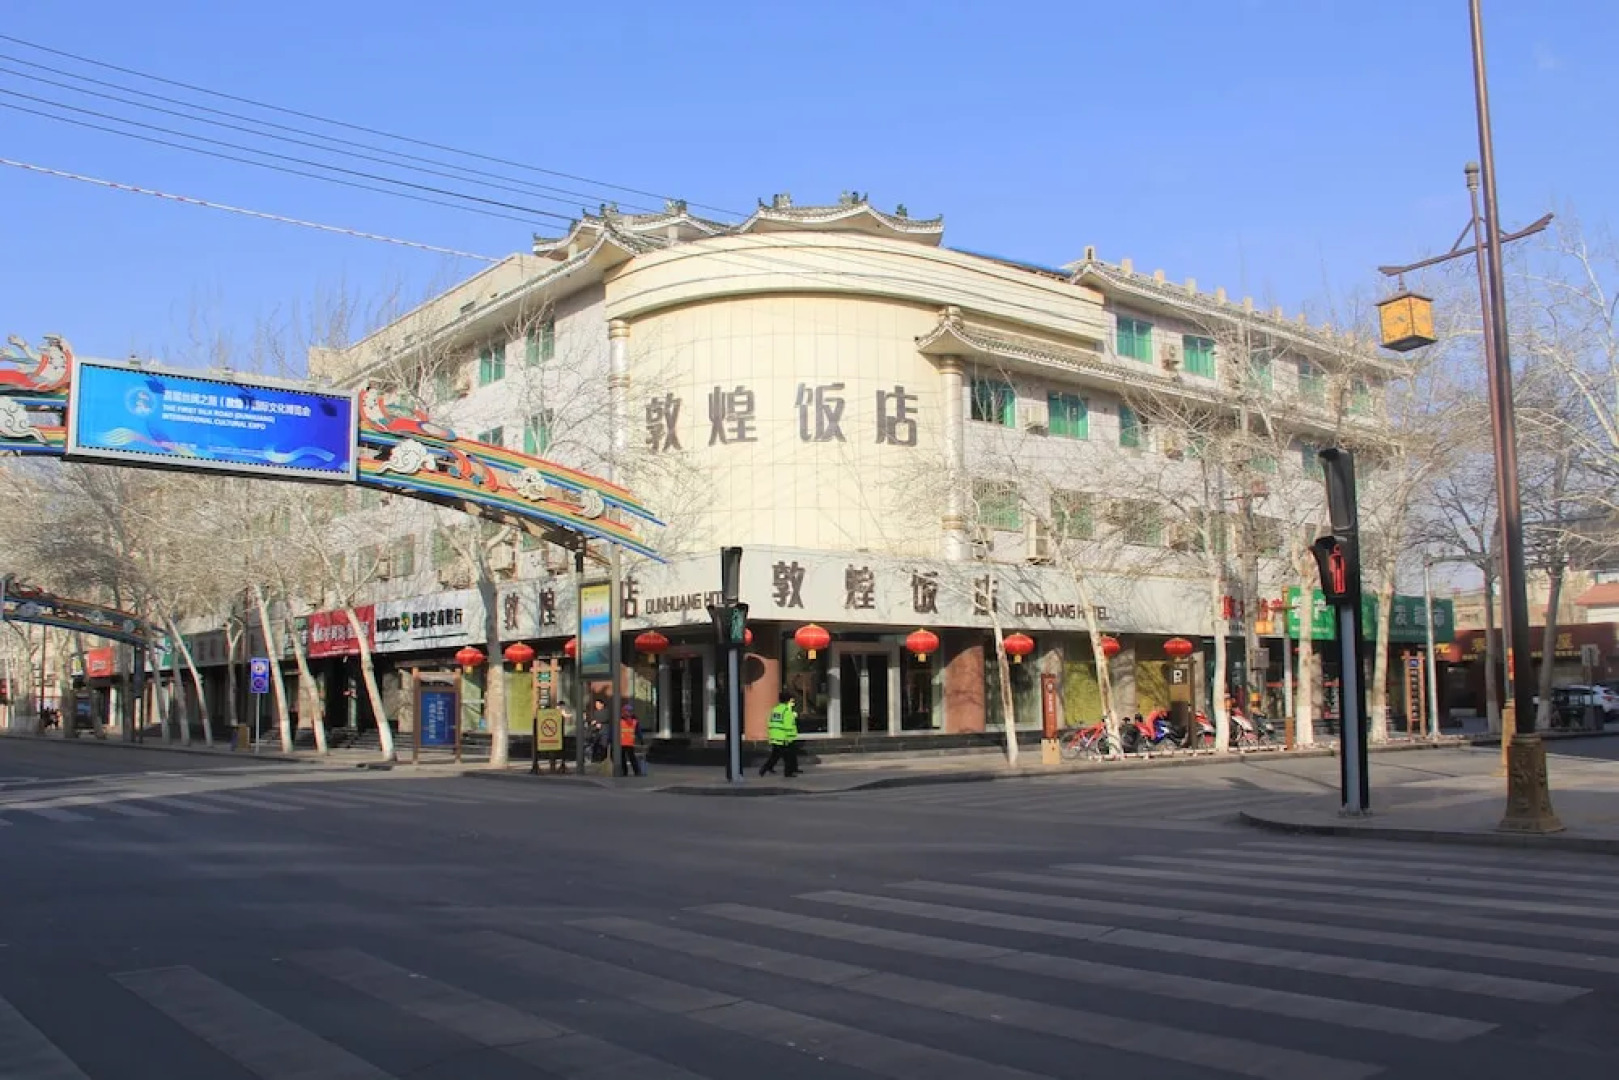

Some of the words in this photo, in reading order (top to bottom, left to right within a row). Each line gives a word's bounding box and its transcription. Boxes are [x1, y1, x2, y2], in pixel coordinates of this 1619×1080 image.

[645, 382, 918, 455] 敦煌饭店
[645, 593, 702, 615] DUNHUANG
[1014, 601, 1076, 619] DUNHUANG
